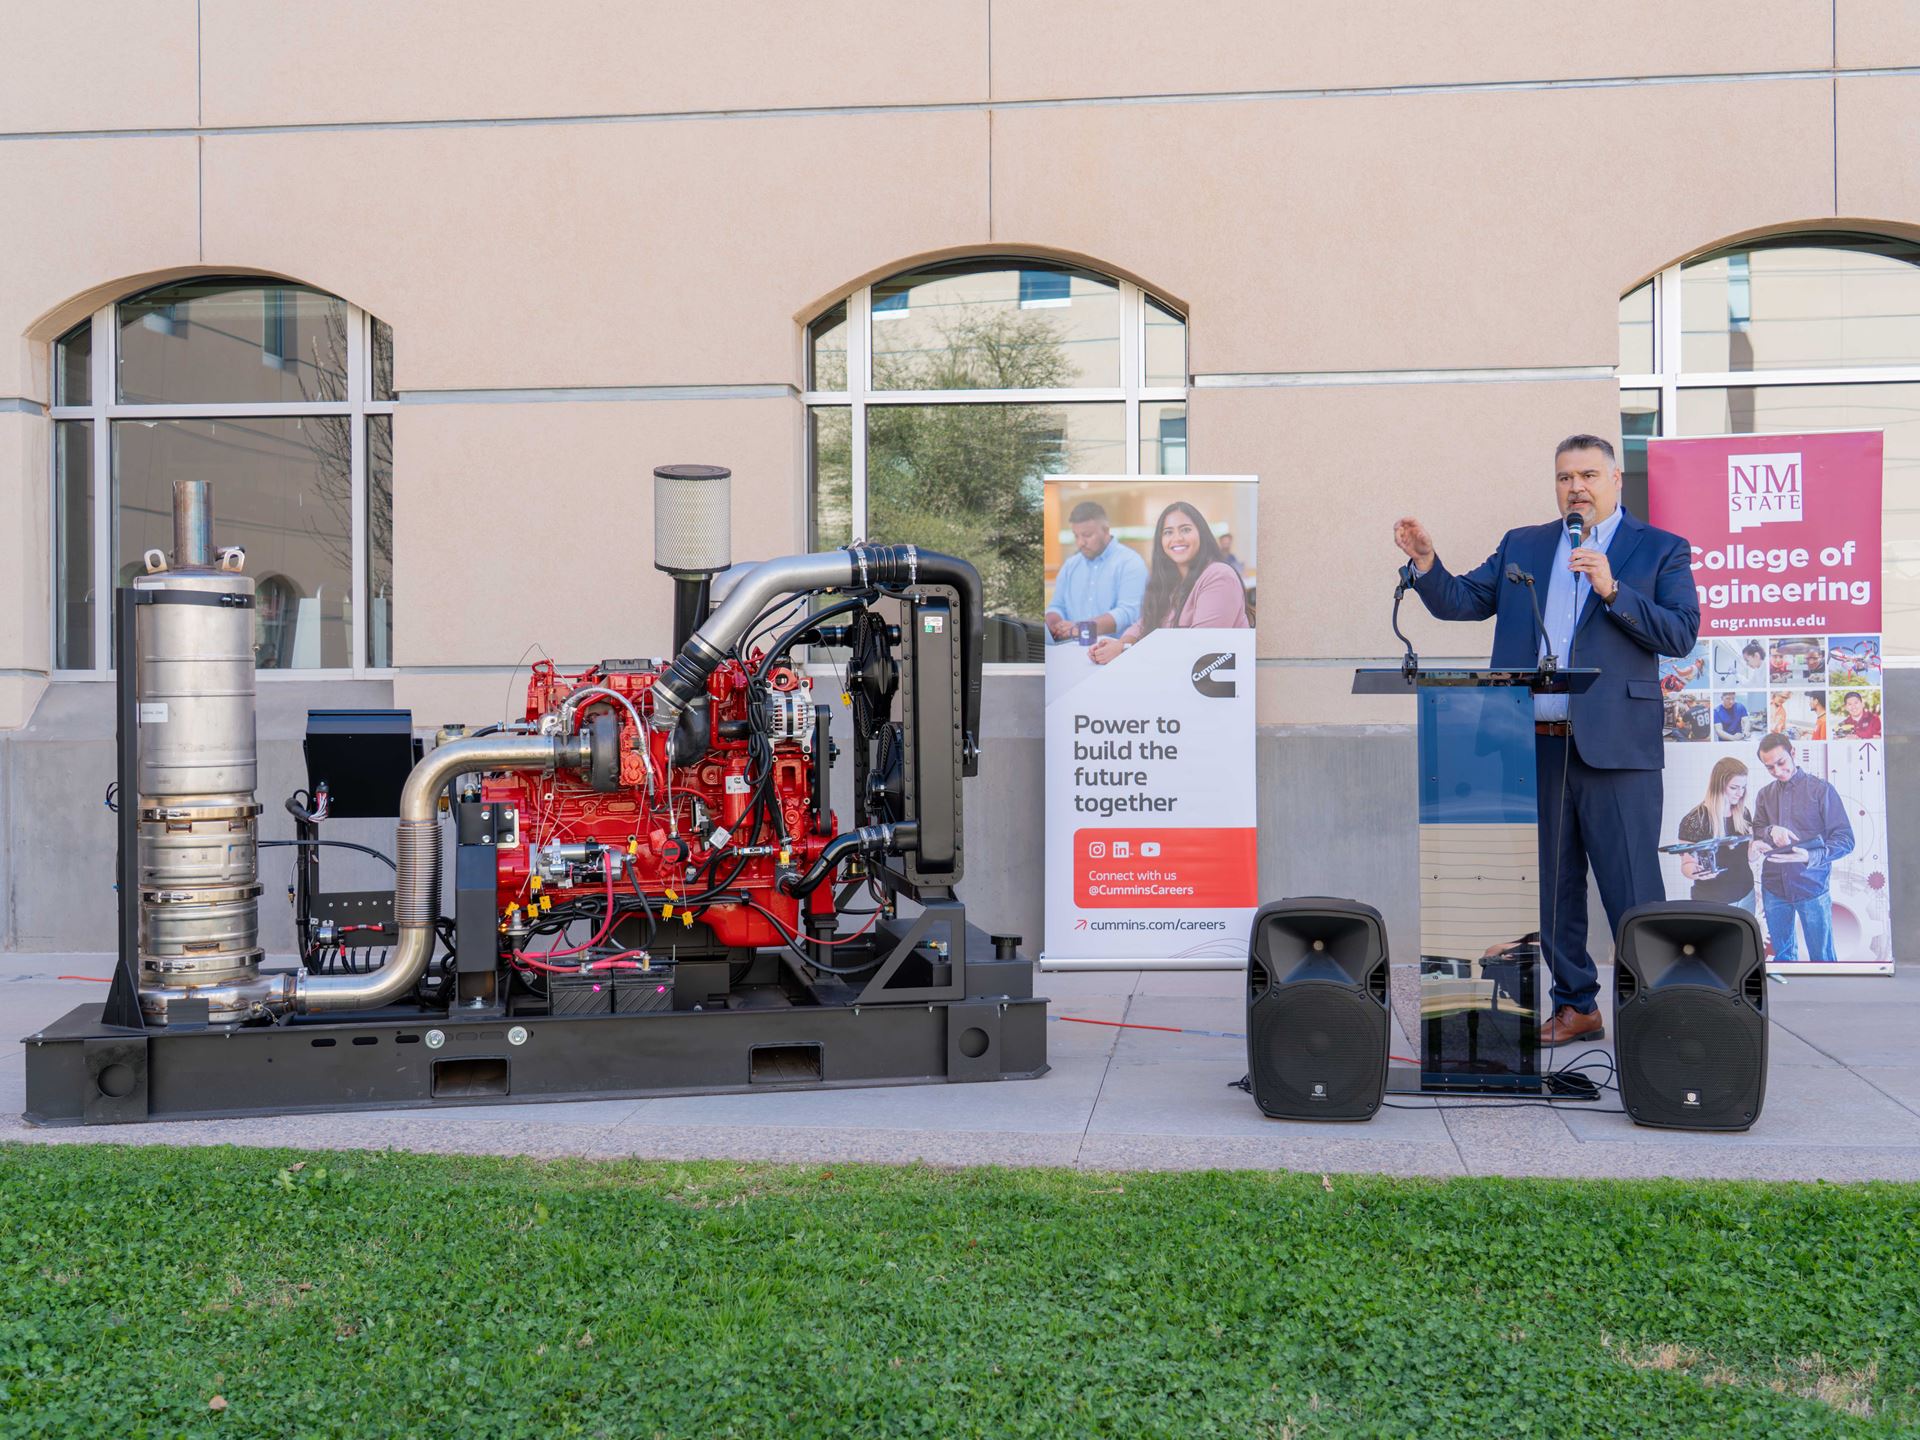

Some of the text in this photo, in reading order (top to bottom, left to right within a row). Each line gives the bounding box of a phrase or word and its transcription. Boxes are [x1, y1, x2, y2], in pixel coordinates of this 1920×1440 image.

[1731, 463, 1800, 494] NM
[1731, 494, 1801, 512] STATE
[1819, 541, 1856, 566] of
[1694, 576, 1871, 609] ngineering
[1710, 613, 1826, 629] engr.nmsu.edu
[1192, 652, 1233, 682] Cummins
[1074, 715, 1181, 734] Power to
[1074, 741, 1178, 760] build the
[1074, 767, 1148, 786] future
[1074, 793, 1178, 818] together
[1088, 870, 1177, 881] Connect with us
[1088, 884, 1194, 896] @CumminsCareers
[1090, 919, 1226, 931] cummins.com/careers
